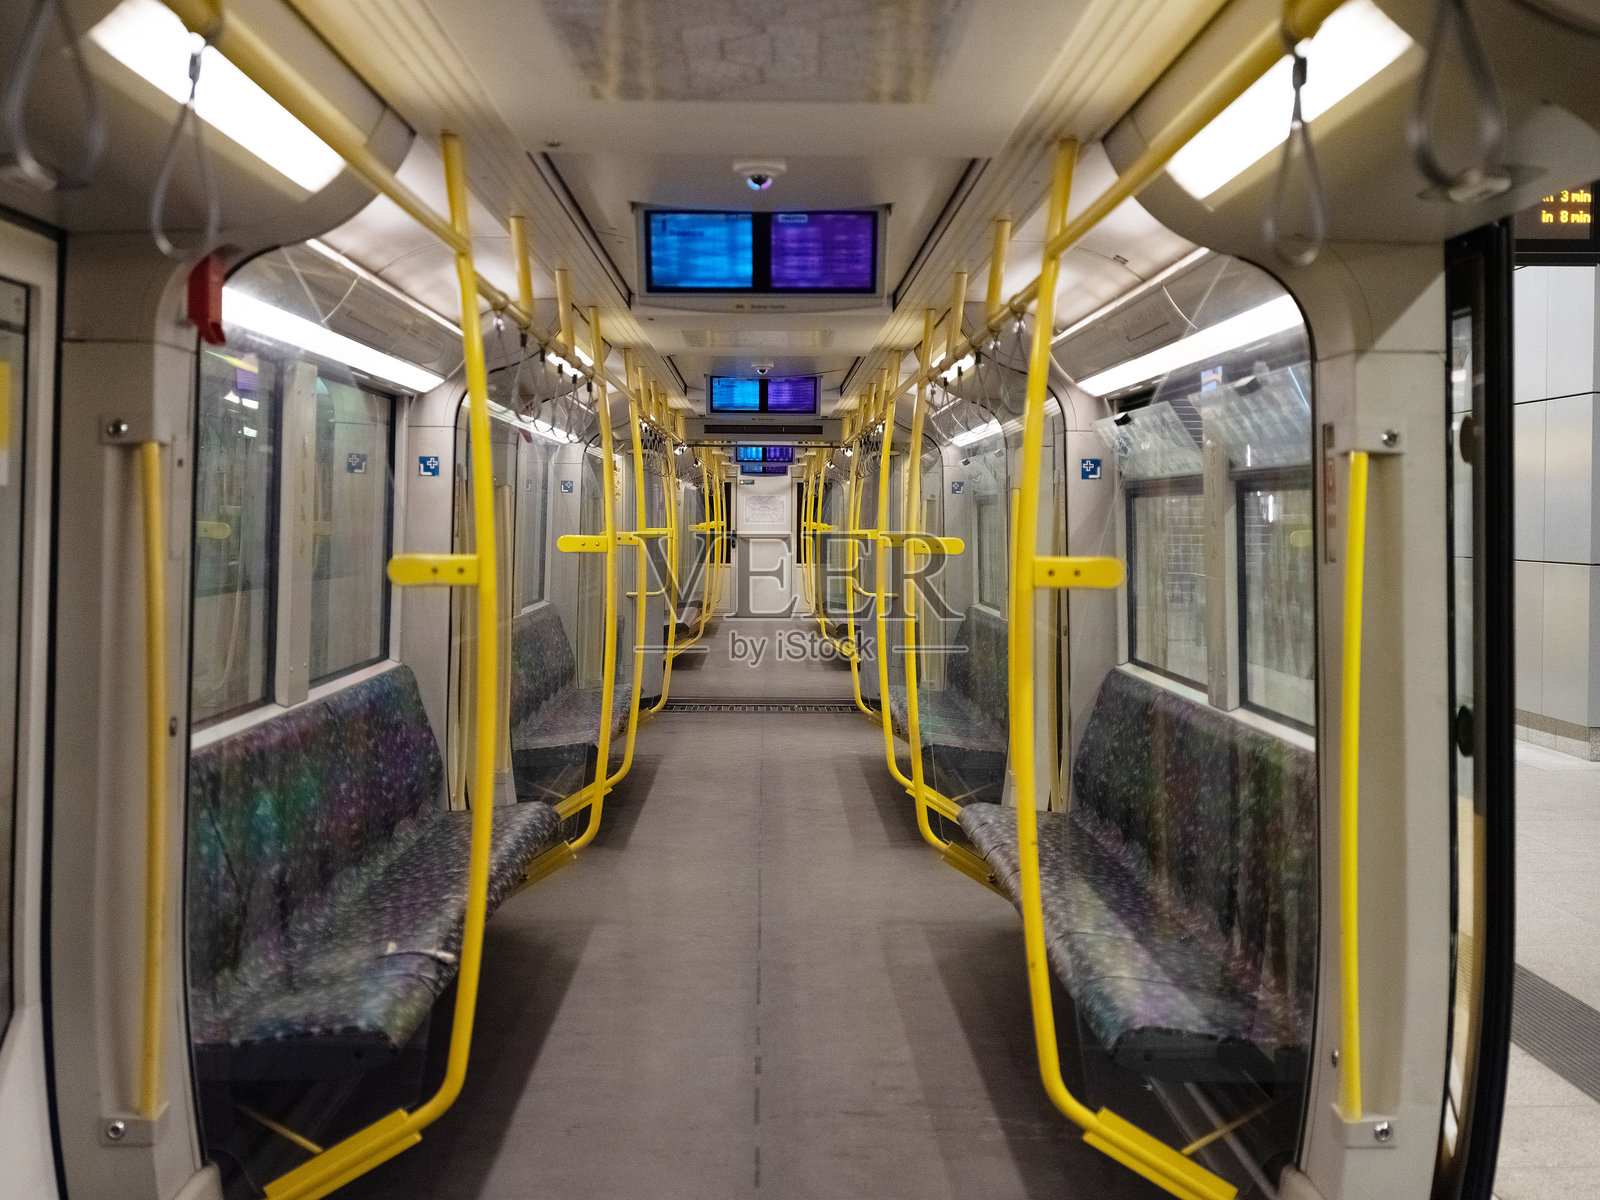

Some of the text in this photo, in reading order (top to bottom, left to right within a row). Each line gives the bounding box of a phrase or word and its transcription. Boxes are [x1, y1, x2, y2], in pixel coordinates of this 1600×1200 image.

[1560, 189, 1569, 203] 3
[1571, 189, 1592, 203] min
[1541, 210, 1592, 223] in 8 min
